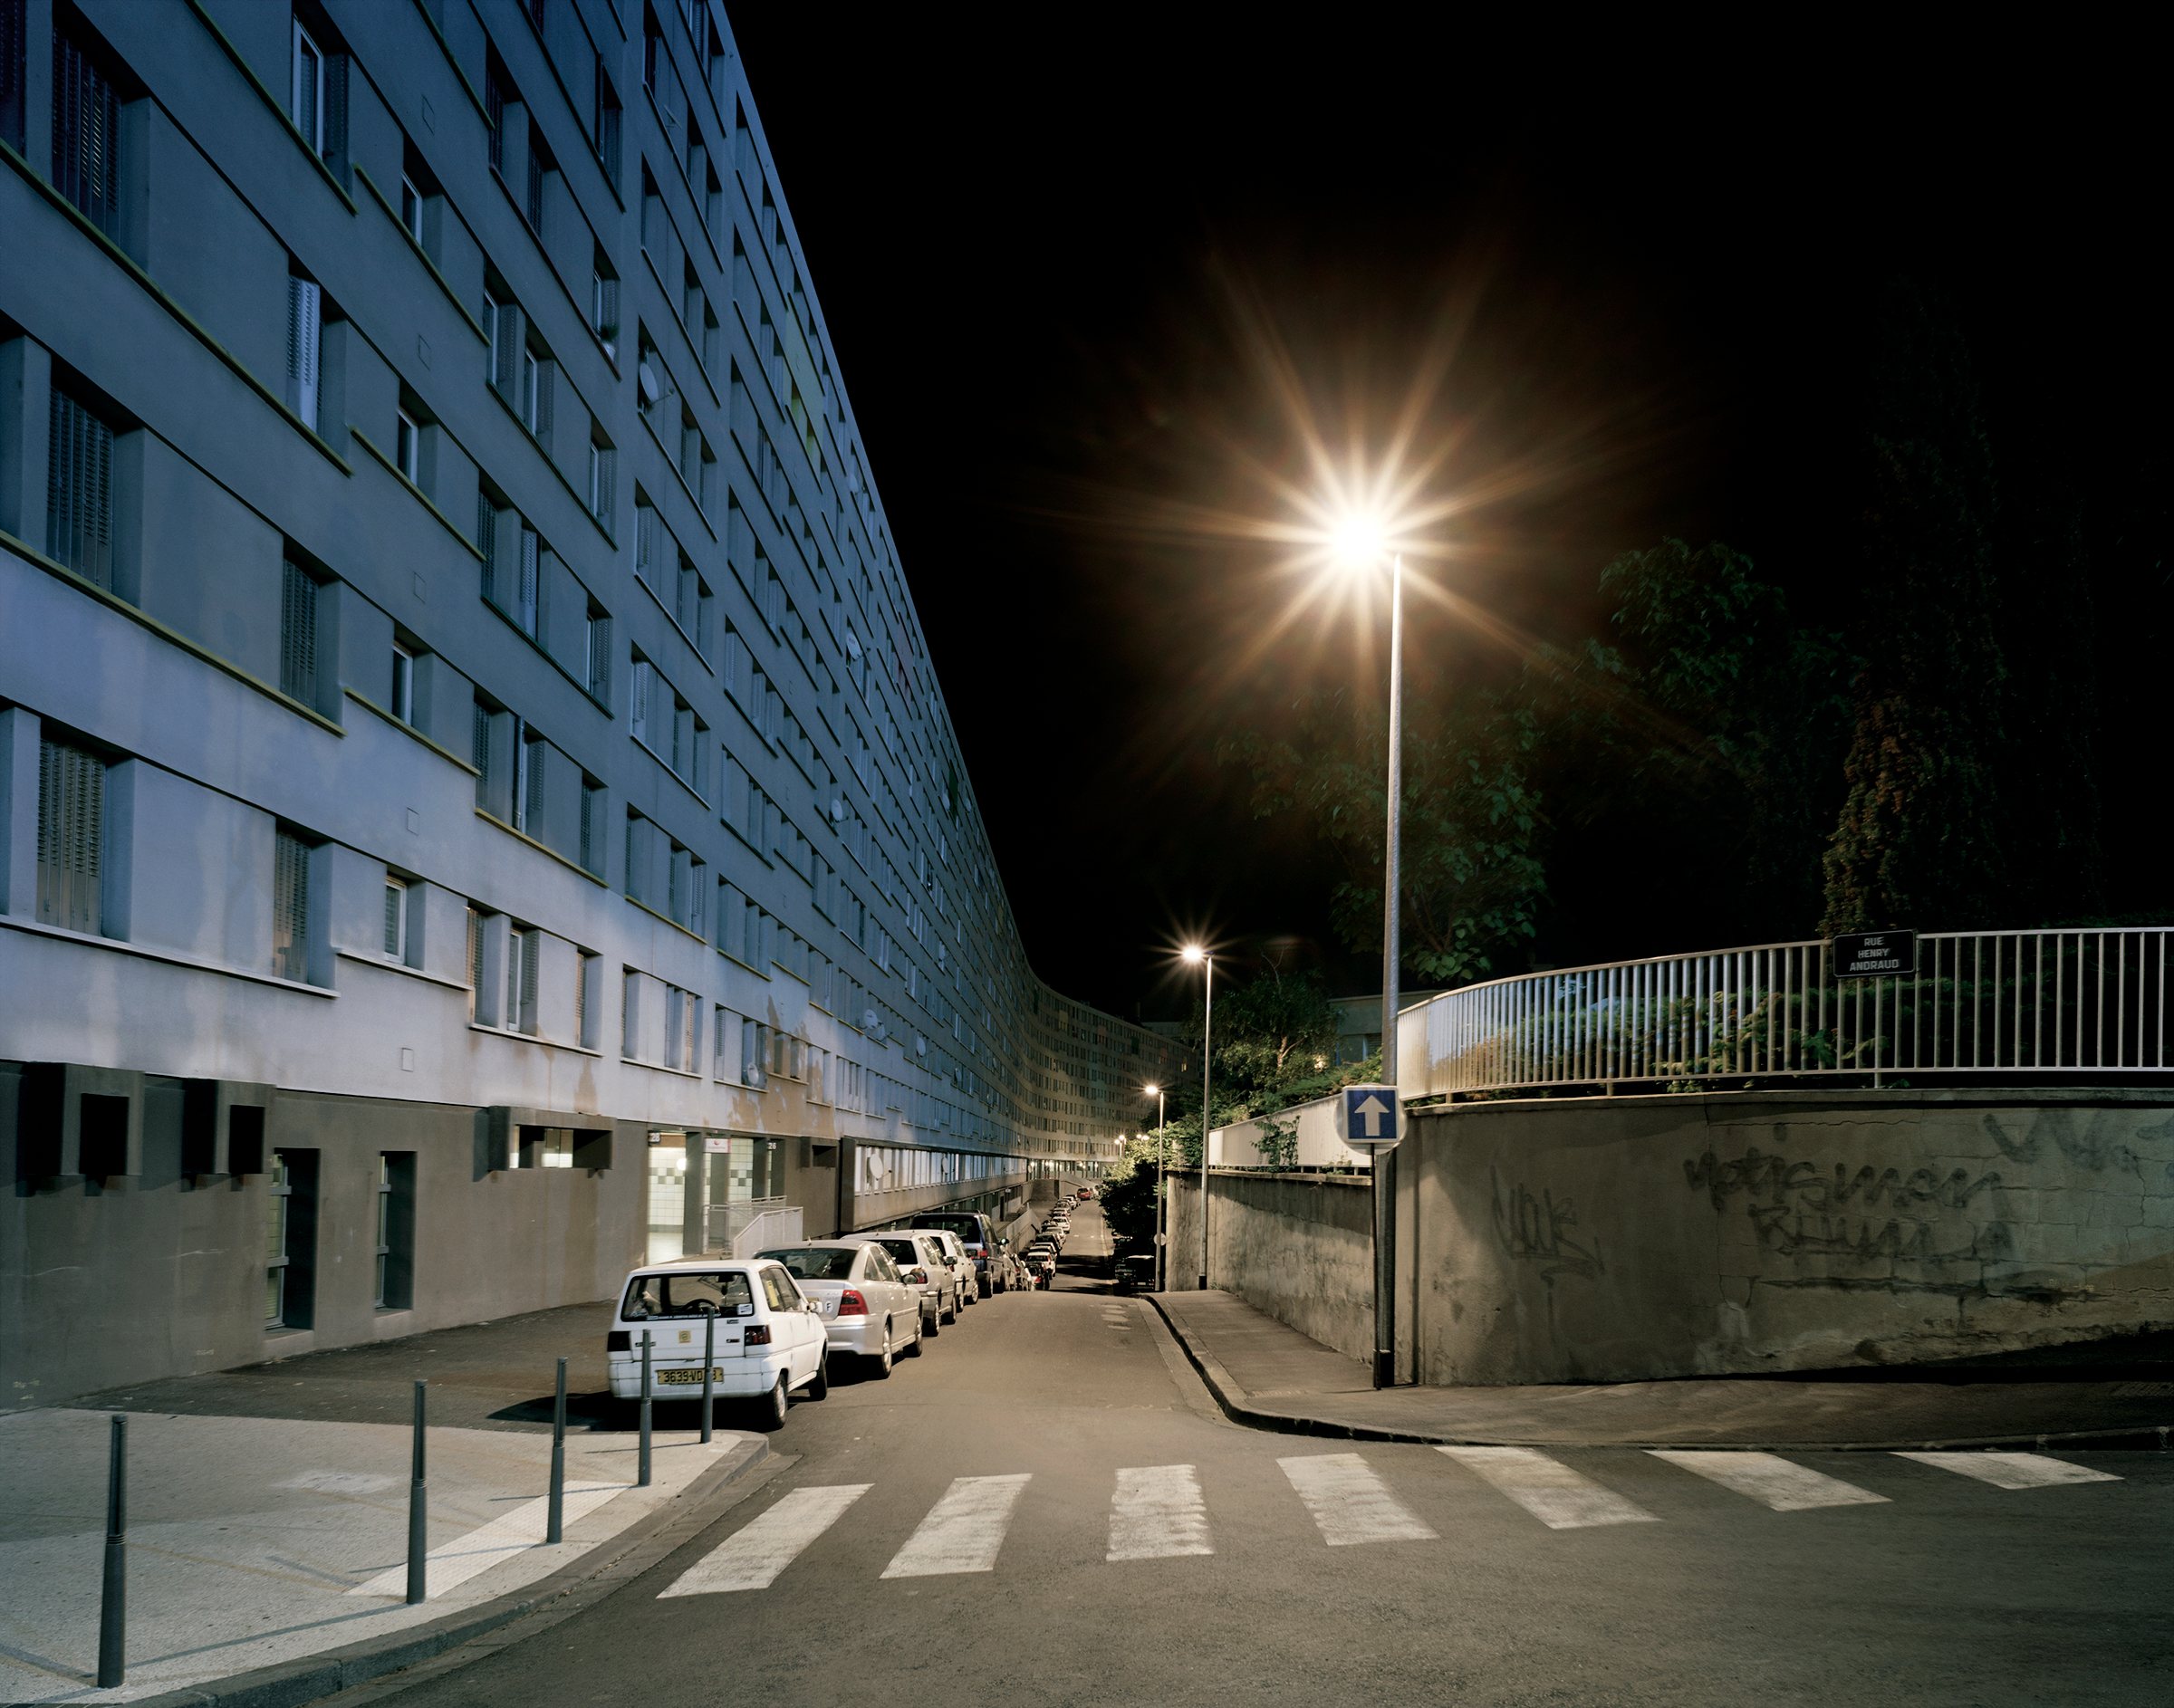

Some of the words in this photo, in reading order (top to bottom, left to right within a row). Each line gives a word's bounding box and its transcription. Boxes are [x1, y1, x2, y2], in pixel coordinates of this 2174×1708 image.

[1863, 936, 1884, 946] RUE
[1857, 948, 1890, 958] HENRY
[1849, 959, 1900, 972] ANDRAUD
